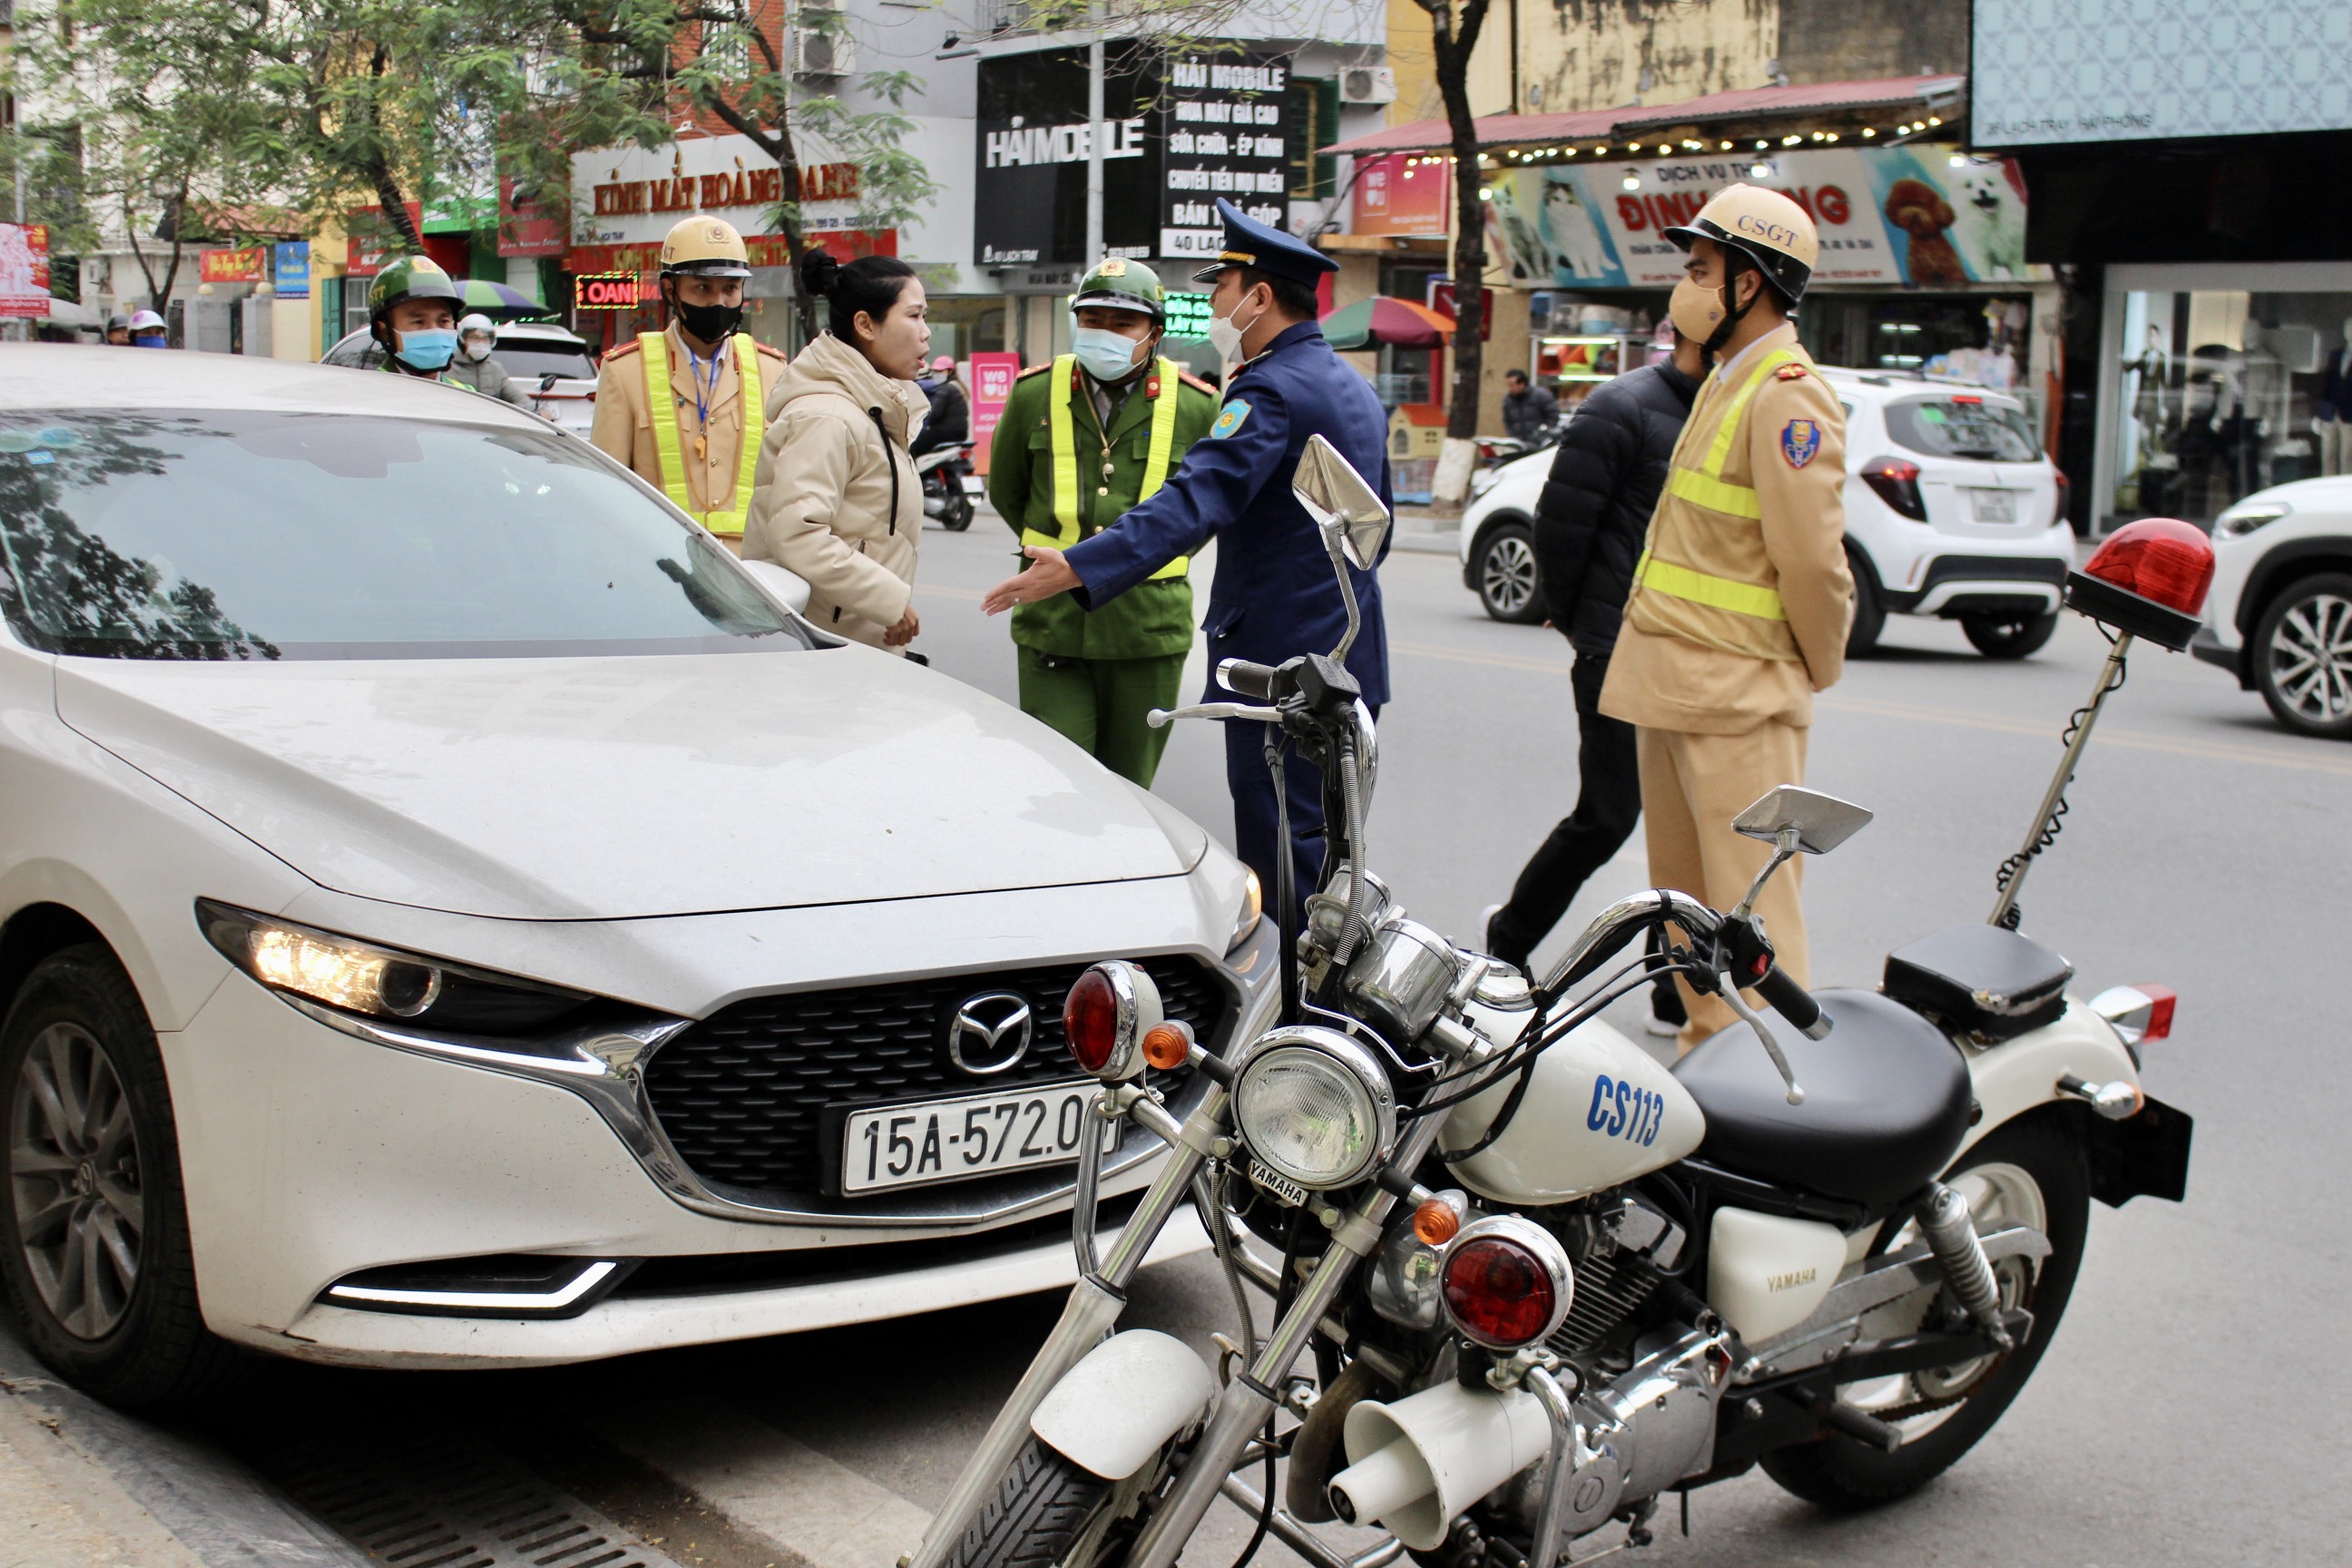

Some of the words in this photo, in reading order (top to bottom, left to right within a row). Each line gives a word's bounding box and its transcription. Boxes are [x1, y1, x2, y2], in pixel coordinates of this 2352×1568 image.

[1172, 55, 1207, 88] HẢI
[1210, 64, 1286, 92] MOBILE
[1175, 101, 1203, 122] MUA
[1204, 99, 1231, 123] MÁY
[1232, 101, 1253, 123] GIÁ
[1254, 104, 1279, 125] CAO
[1195, 131, 1229, 155] CHỮA
[1236, 132, 1253, 156] ÉP
[1254, 132, 1284, 157] KÍNH
[593, 168, 650, 216] KÍNH
[649, 150, 698, 213] MẮT
[700, 155, 780, 209] HOÀNG
[1657, 165, 1700, 185] DỊCH
[1702, 163, 1727, 183] VỤ
[1730, 160, 1779, 179] THY
[1172, 200, 1210, 226] BÁN
[1175, 235, 1192, 250] 40
[1739, 215, 1798, 248] CSGT
[983, 370, 1007, 383] we
[1587, 1074, 1663, 1147] CS113
[864, 1094, 1084, 1181] 15A-572.0
[1250, 1161, 1303, 1203] YAMAHA
[1767, 1268, 1816, 1293] YAMAHA
